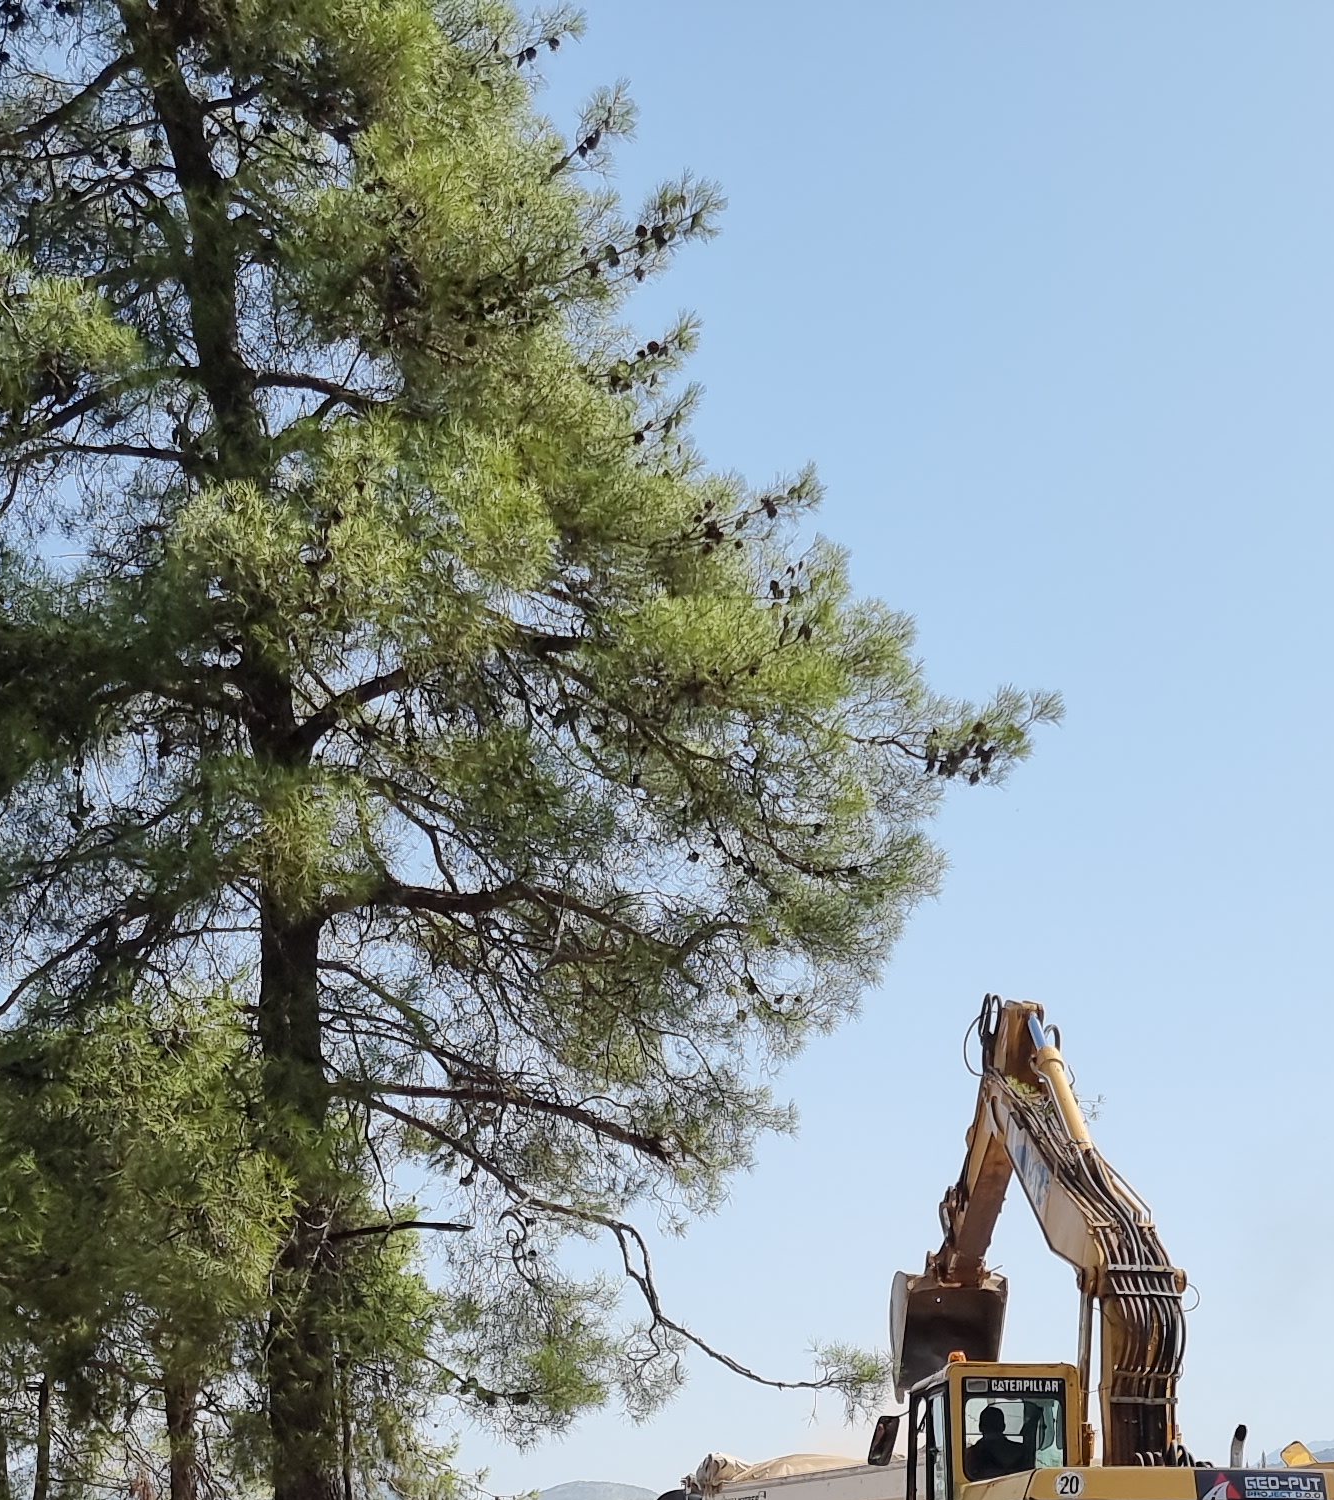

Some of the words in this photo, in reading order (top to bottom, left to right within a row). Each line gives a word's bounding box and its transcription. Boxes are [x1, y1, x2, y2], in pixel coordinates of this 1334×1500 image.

[991, 1380, 1059, 1392] CATERPILLAR
[1059, 1475, 1080, 1495] 20
[1244, 1476, 1321, 1491] GEO-PUT
[1247, 1490, 1292, 1498] PROJECT
